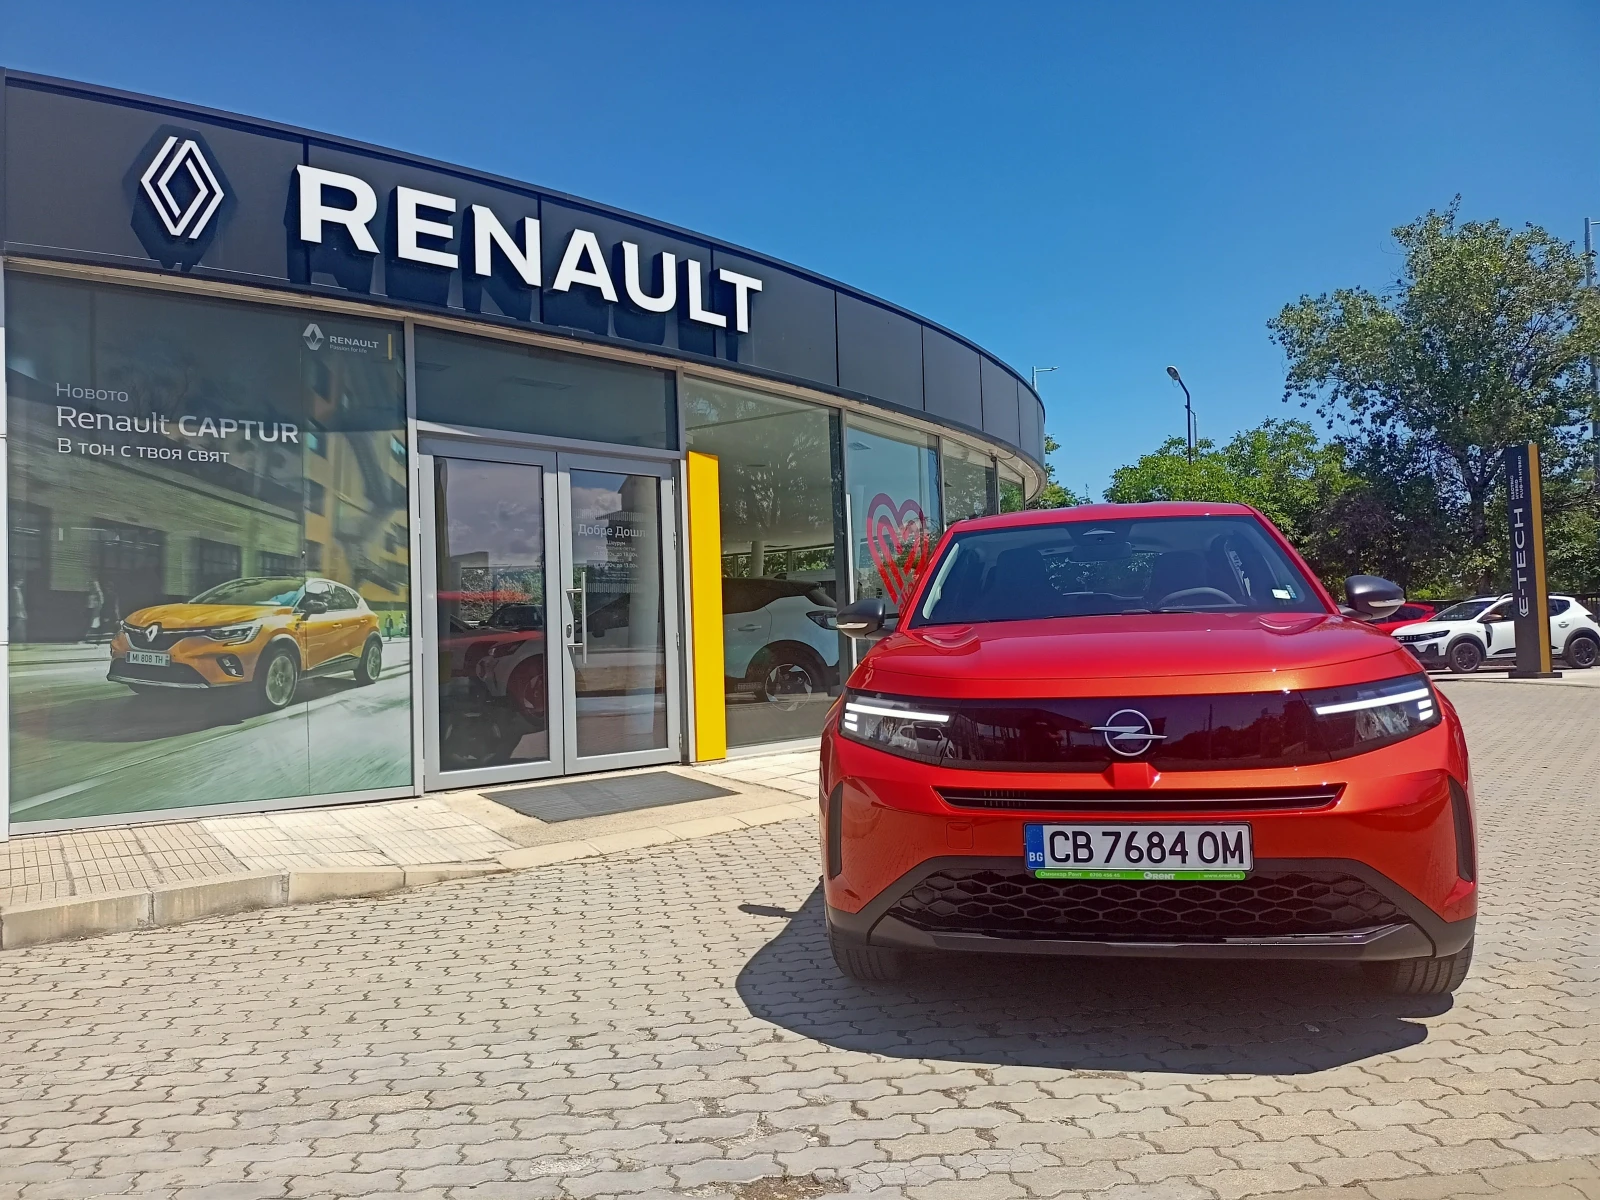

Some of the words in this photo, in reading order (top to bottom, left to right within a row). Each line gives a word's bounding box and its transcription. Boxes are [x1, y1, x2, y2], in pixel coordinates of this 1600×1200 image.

[296, 164, 763, 333] RENAULT
[329, 335, 379, 349] RENAULT
[329, 344, 350, 352] Passion
[56, 382, 129, 402] Новото
[56, 405, 170, 435] Renault
[178, 415, 299, 444] CAPTUR
[57, 437, 72, 454] В
[77, 442, 115, 456] тон
[120, 445, 131, 458] с
[136, 446, 182, 460] твоя
[187, 449, 230, 463] свят
[578, 523, 613, 538] Добре
[615, 525, 651, 538] Дошл
[1513, 508, 1529, 617] E-TECH
[132, 653, 140, 661] MI
[154, 655, 163, 664] TH
[1029, 852, 1043, 862] BG
[1049, 831, 1094, 863] CB
[1101, 831, 1189, 864] 7684
[1197, 831, 1244, 864] OM
